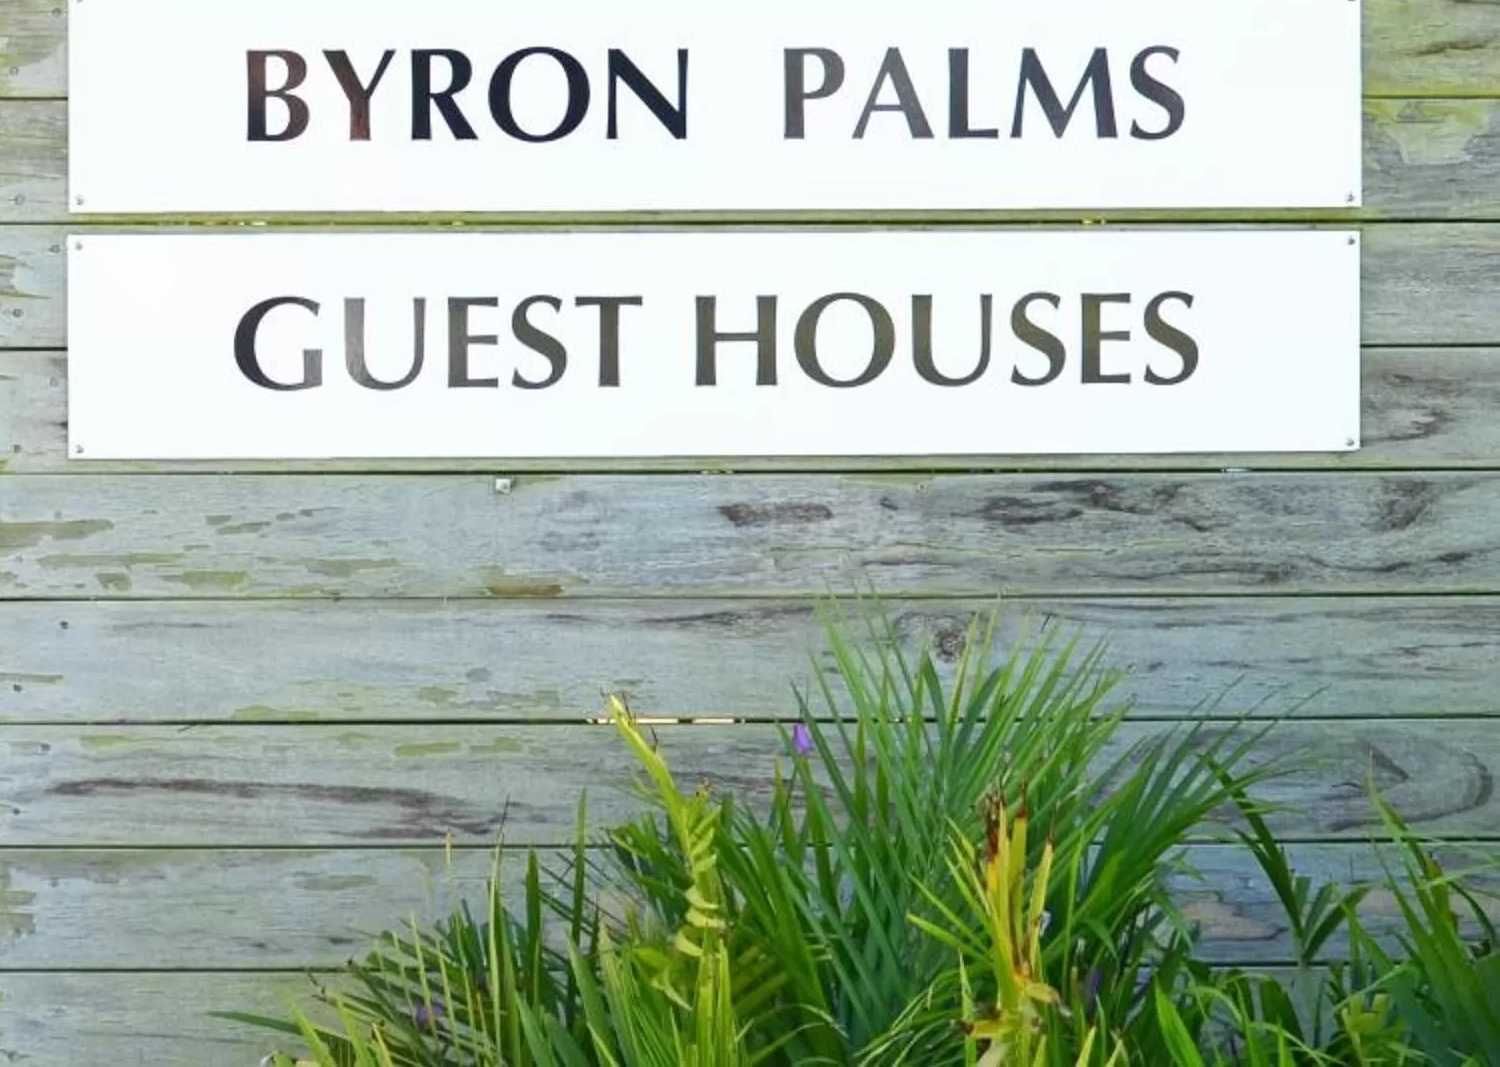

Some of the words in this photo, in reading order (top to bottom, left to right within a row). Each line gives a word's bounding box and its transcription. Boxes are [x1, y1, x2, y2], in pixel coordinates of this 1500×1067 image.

[246, 46, 689, 144] BYRON
[783, 45, 1186, 140] PALMS
[233, 294, 644, 392] GUEST
[695, 290, 1200, 388] HOUSES
